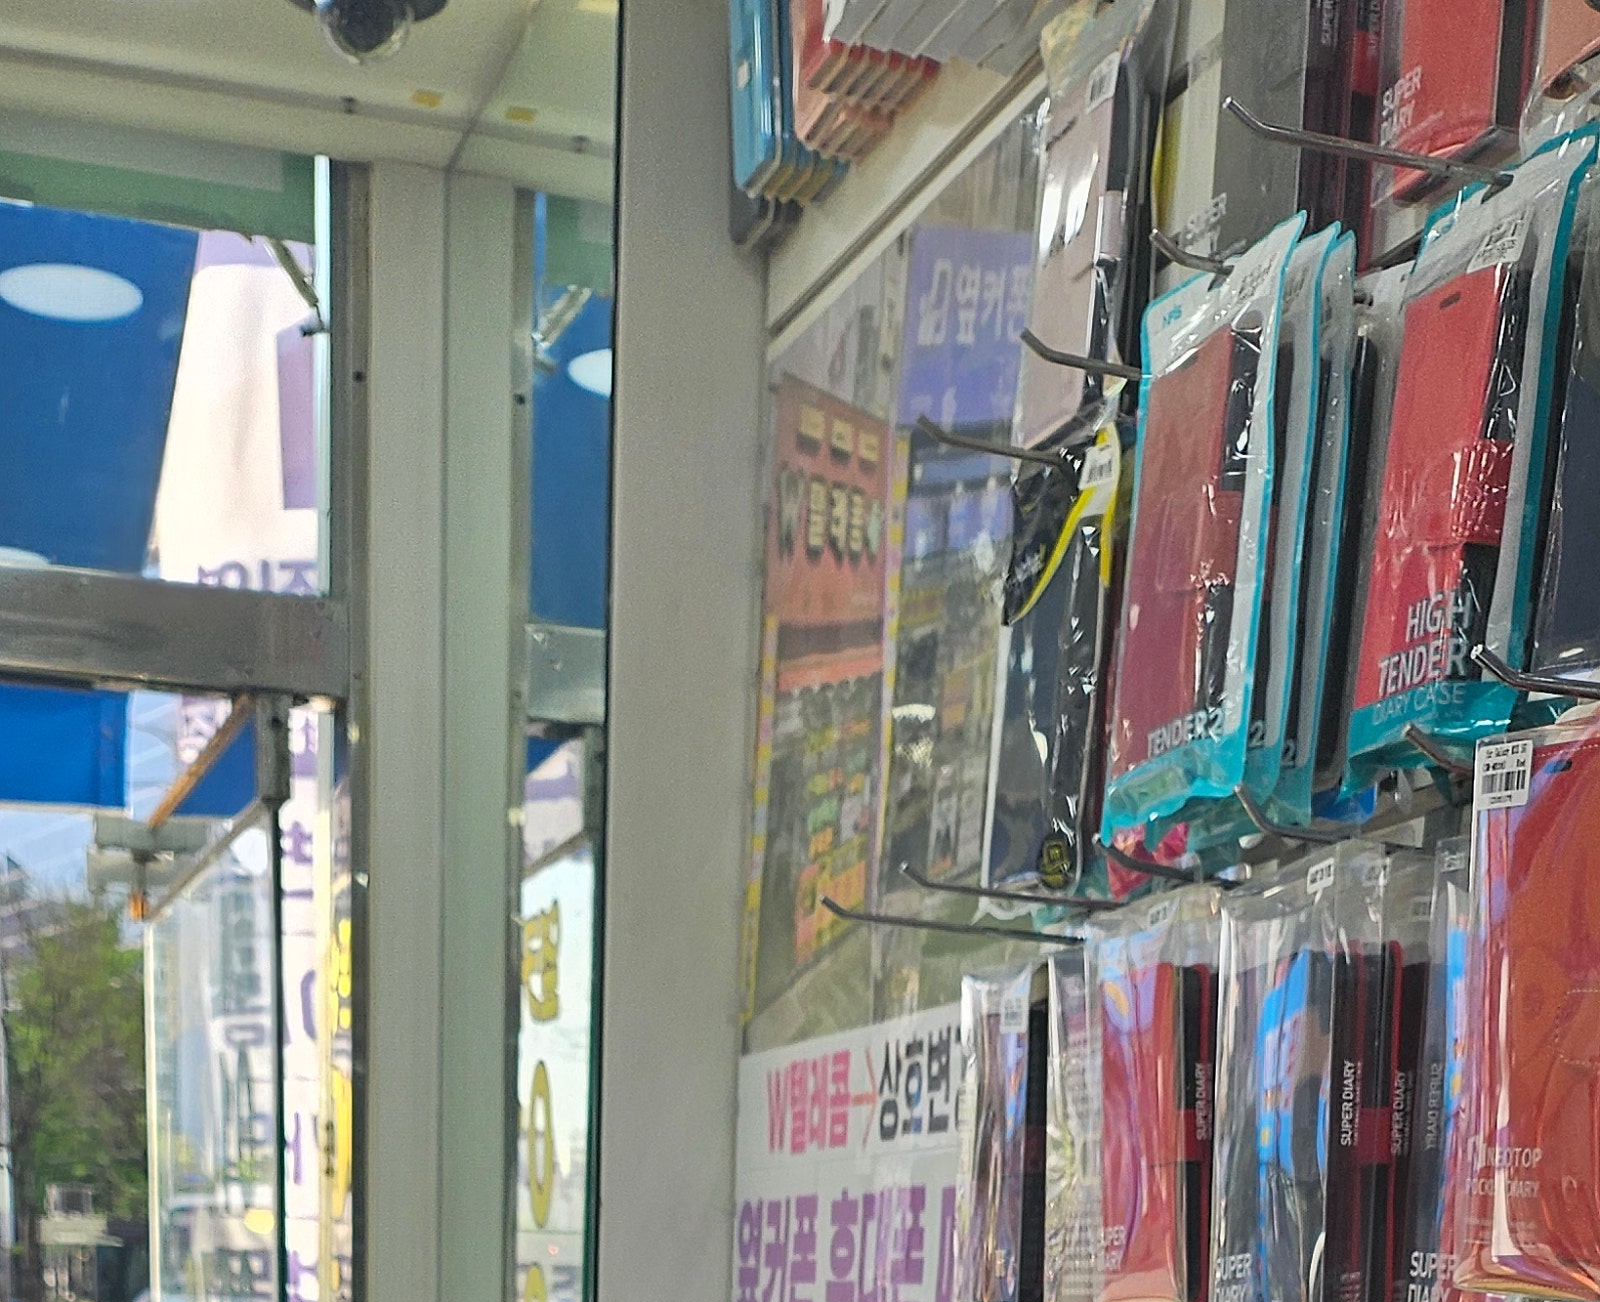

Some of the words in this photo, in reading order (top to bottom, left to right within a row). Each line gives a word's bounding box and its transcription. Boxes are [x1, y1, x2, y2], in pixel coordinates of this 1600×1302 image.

[1405, 590, 1472, 643] HIGH
[1378, 637, 1469, 699] TENDER
[1412, 682, 1467, 713] CASE
[1342, 1060, 1355, 1100] DIARY
[1340, 1102, 1353, 1147] SUPER
[1391, 1111, 1402, 1156] SUPER
[1214, 1253, 1252, 1281] SUPER
[1409, 1250, 1459, 1281] SUPER
